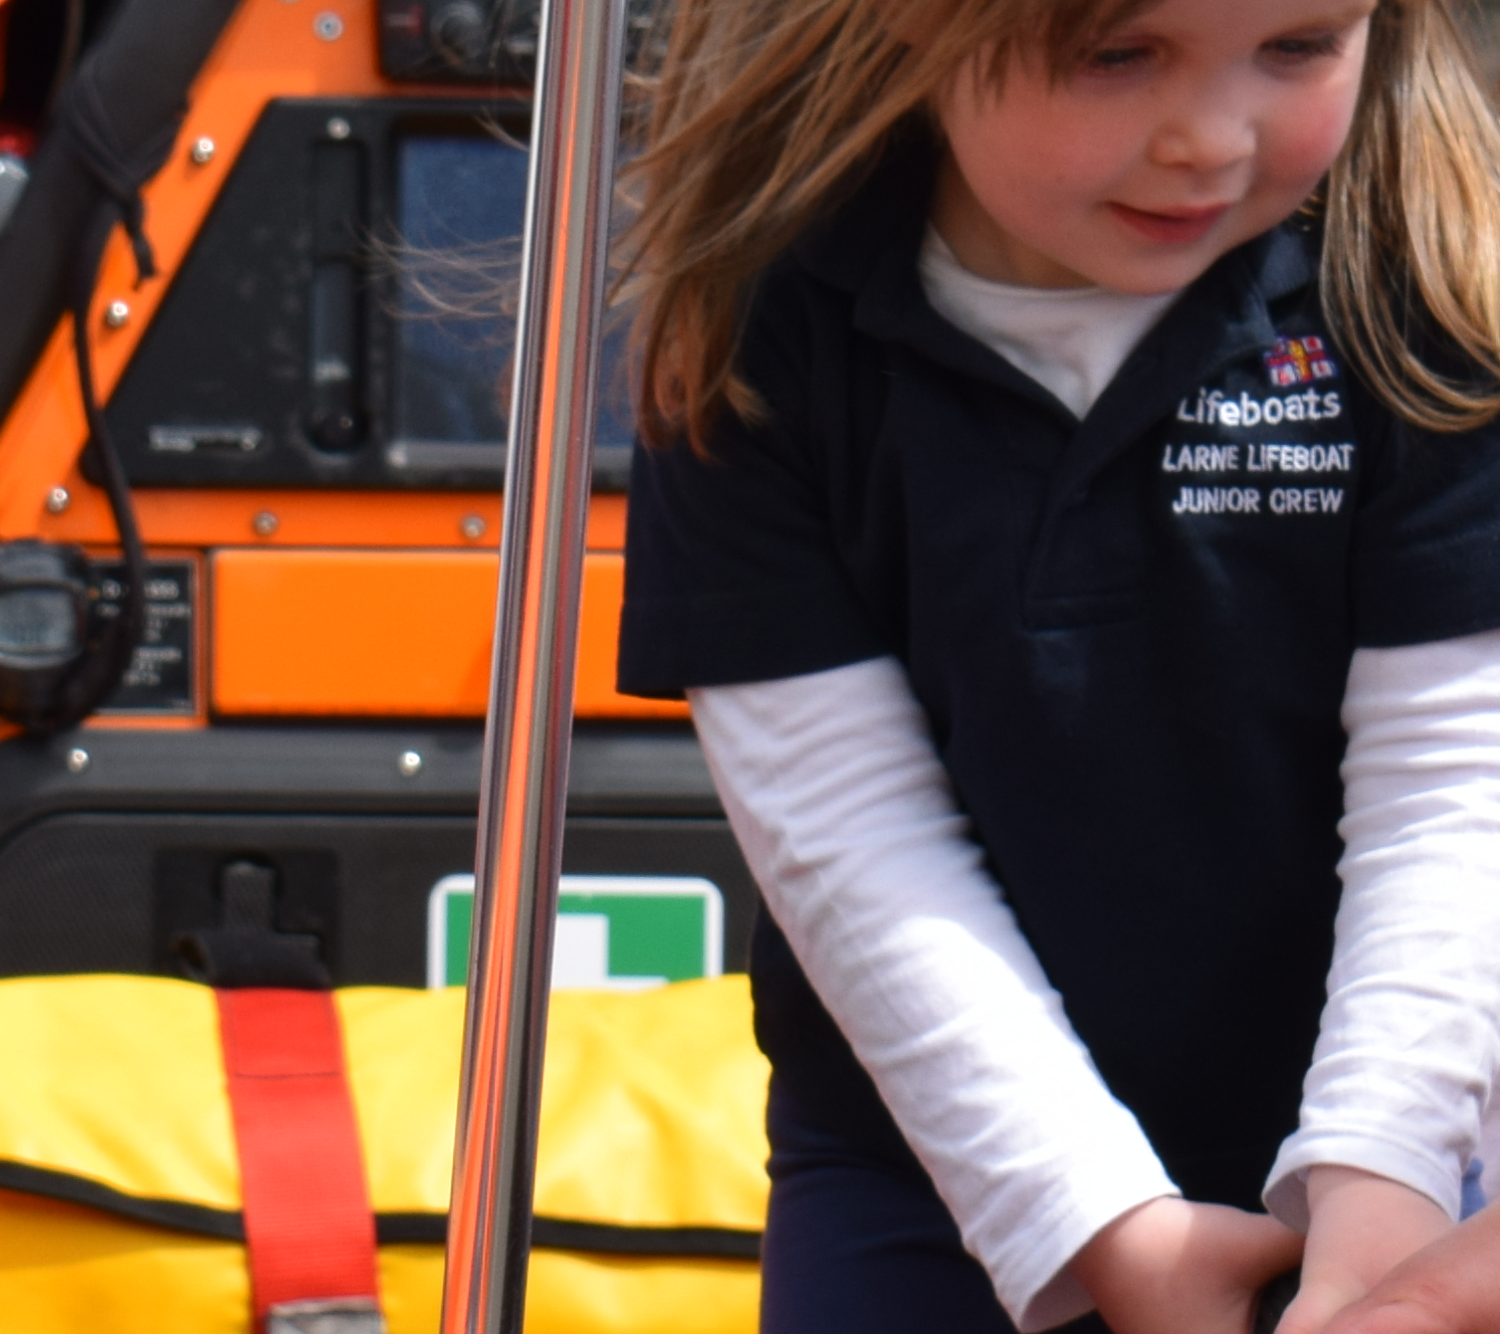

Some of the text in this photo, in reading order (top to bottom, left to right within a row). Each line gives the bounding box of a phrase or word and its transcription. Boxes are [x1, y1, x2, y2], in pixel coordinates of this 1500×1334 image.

[1176, 386, 1342, 427] Lifeboats
[1161, 443, 1354, 473] LARNE LIFEBOAT
[1172, 485, 1344, 515] JUNIOR CREW
